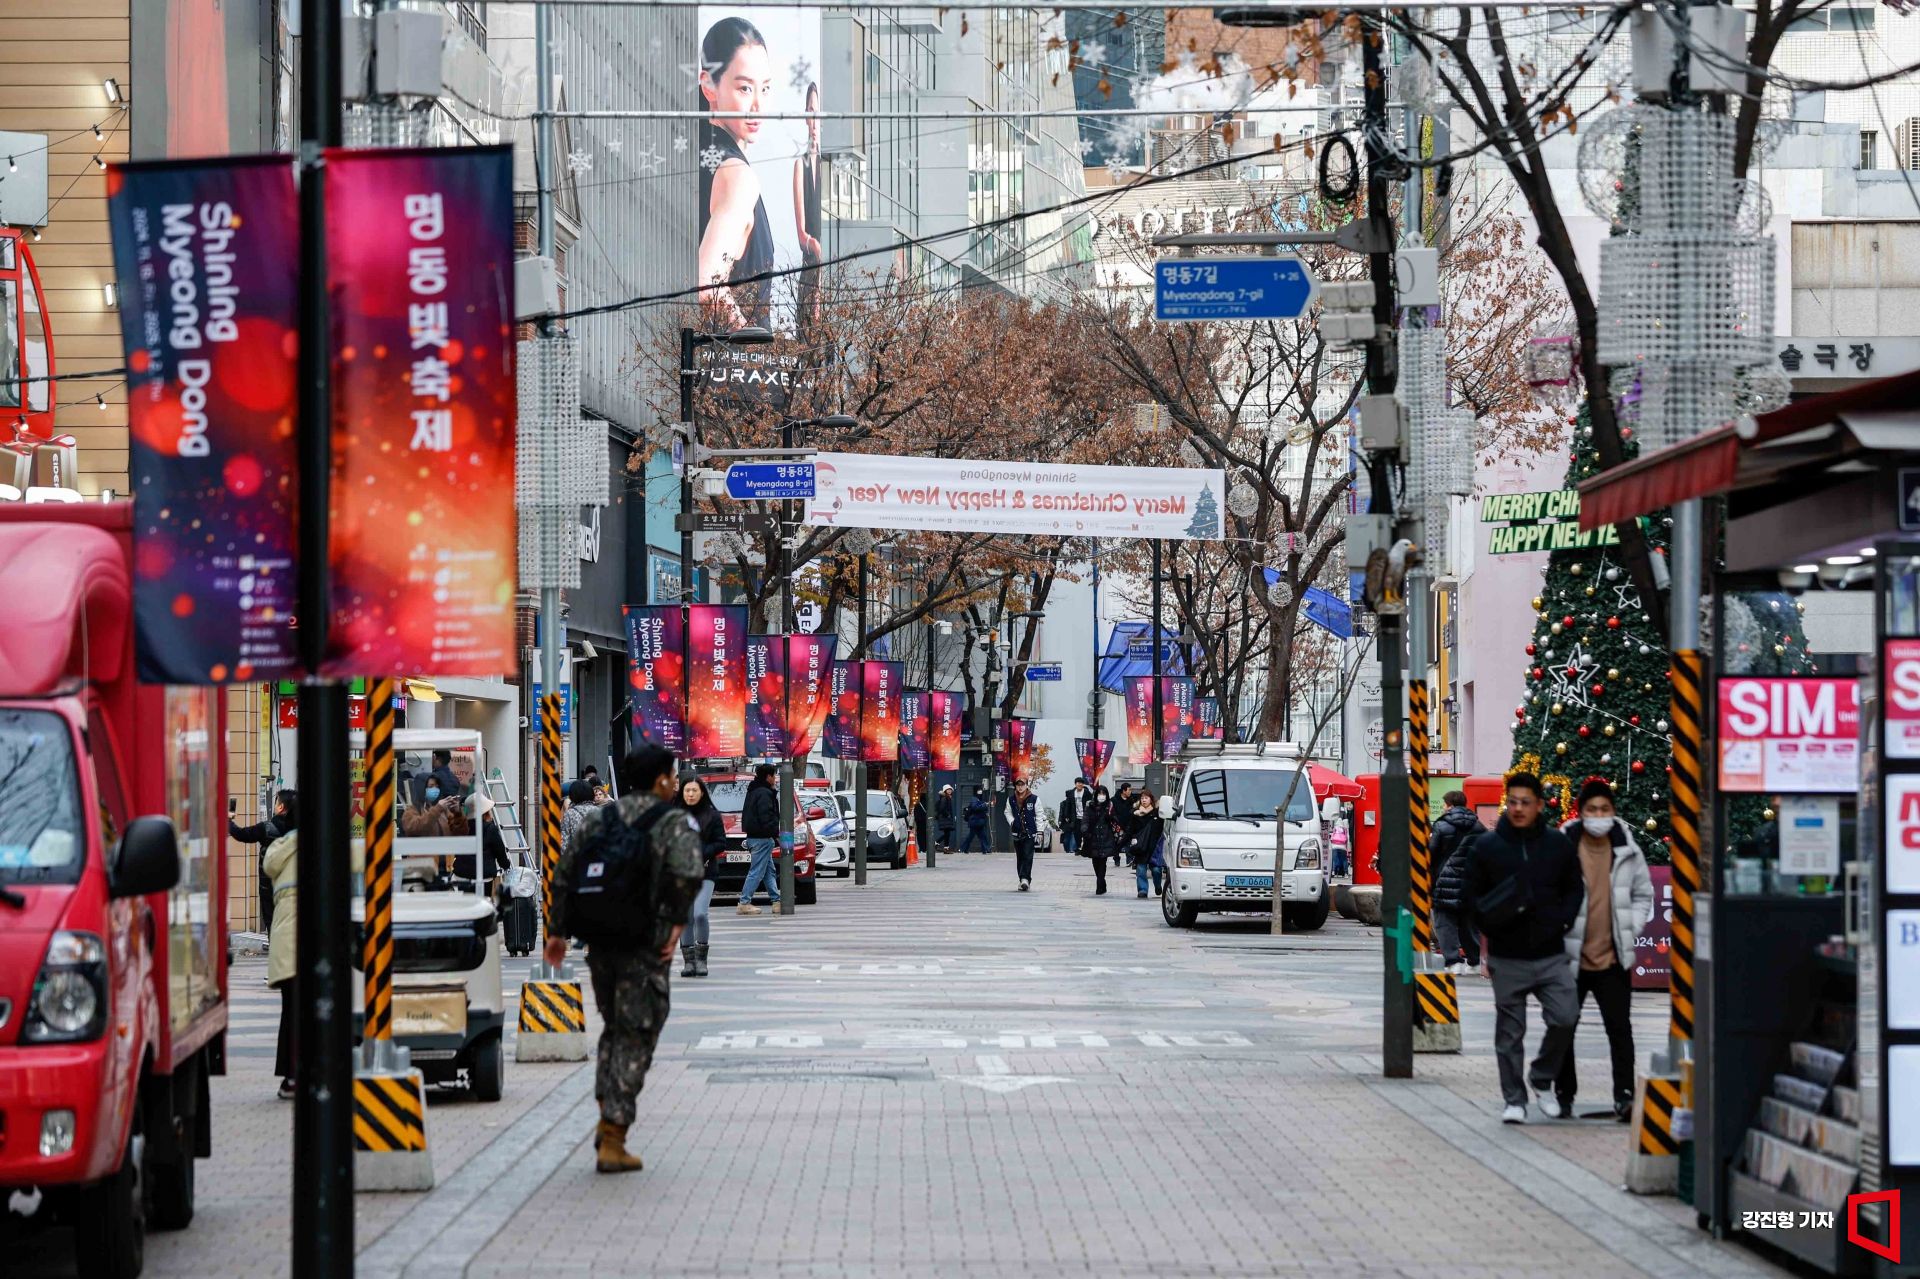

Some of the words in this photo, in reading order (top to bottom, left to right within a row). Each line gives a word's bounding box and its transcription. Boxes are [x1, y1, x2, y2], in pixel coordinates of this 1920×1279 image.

[159, 203, 202, 349] Myeong
[200, 202, 240, 342] Shining
[1163, 266, 1218, 284] 명동7길
[1163, 290, 1235, 302] Myeongdong
[1238, 288, 1264, 300] 7-gil
[177, 359, 211, 457] Dong
[746, 480, 794, 488] Myeongdong
[796, 480, 812, 488] 8-gil
[776, 466, 812, 478] 명동8길
[1482, 492, 1547, 522] MERRY
[1489, 524, 1549, 554] HAPPY
[639, 618, 650, 659] Myeong
[652, 618, 662, 658] Shining
[713, 618, 725, 691] 명동빛축제
[748, 645, 756, 678] Myeong
[758, 645, 767, 678] Shining
[644, 663, 654, 690] Dong
[838, 668, 847, 694] Shining
[750, 682, 758, 704] Dong
[1728, 680, 1836, 736] SIM
